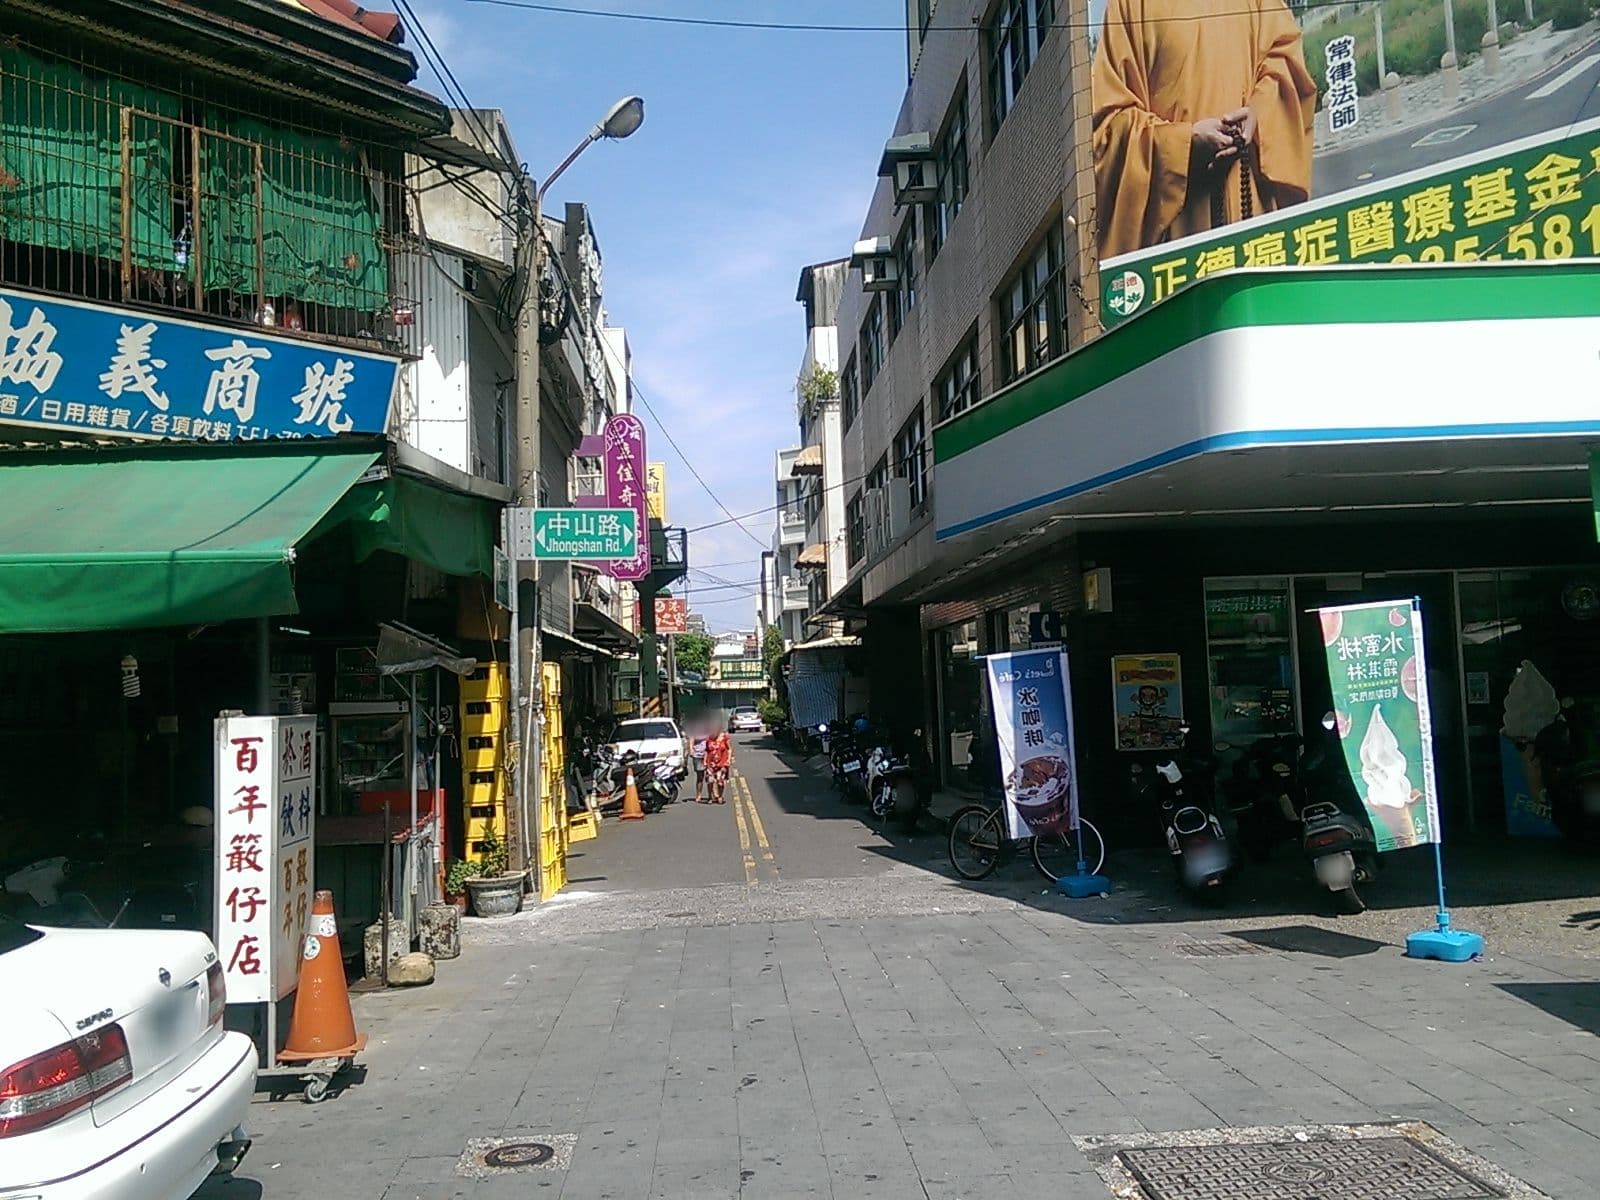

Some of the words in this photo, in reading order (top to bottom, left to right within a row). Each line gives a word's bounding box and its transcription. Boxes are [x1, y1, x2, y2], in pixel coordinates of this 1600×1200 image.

[1328, 38, 1356, 129] 常律法師
[1152, 147, 1600, 305] 正德癌症醫療基金
[0, 297, 354, 434] 協義商號
[546, 538, 603, 556] Jhongshan
[605, 538, 623, 552] Rd.
[548, 512, 622, 536] 中山路
